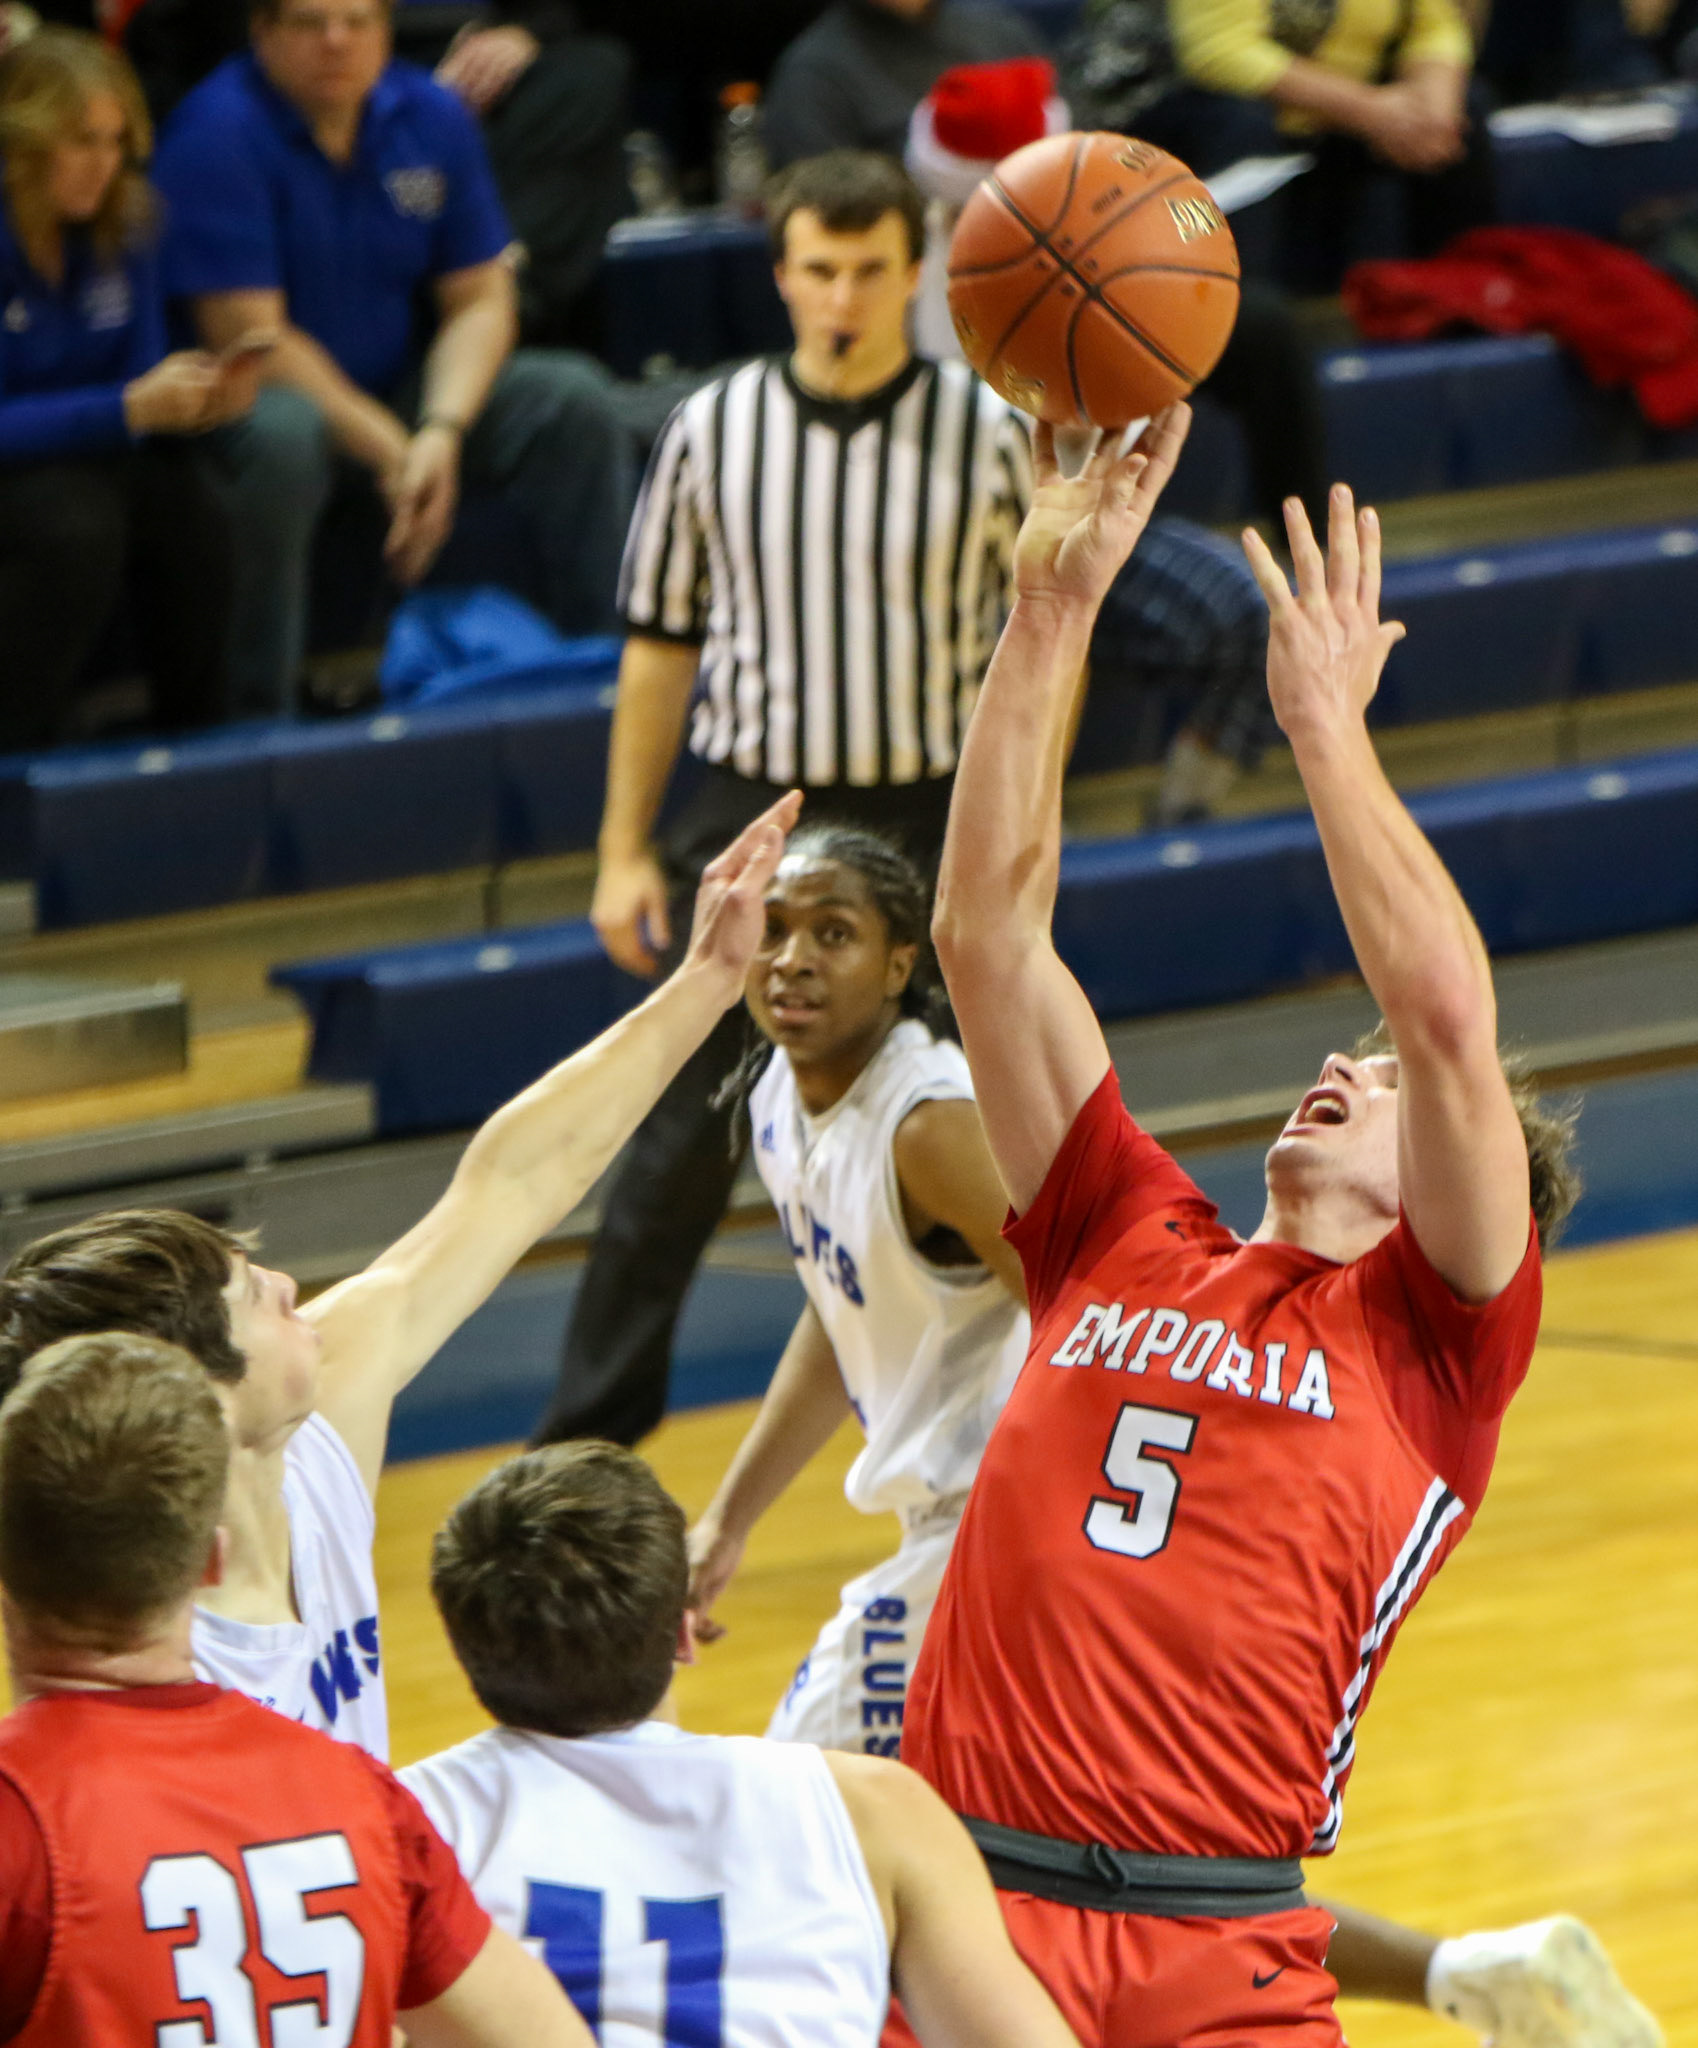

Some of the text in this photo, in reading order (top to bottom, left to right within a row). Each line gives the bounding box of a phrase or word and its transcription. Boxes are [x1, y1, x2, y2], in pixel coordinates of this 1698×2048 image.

[1049, 1302, 1336, 1420] EMPORIA
[1081, 1401, 1200, 1560] 5
[862, 1594, 908, 1759] BLUES
[137, 1830, 365, 2048] 35
[521, 1876, 728, 2048] 11
